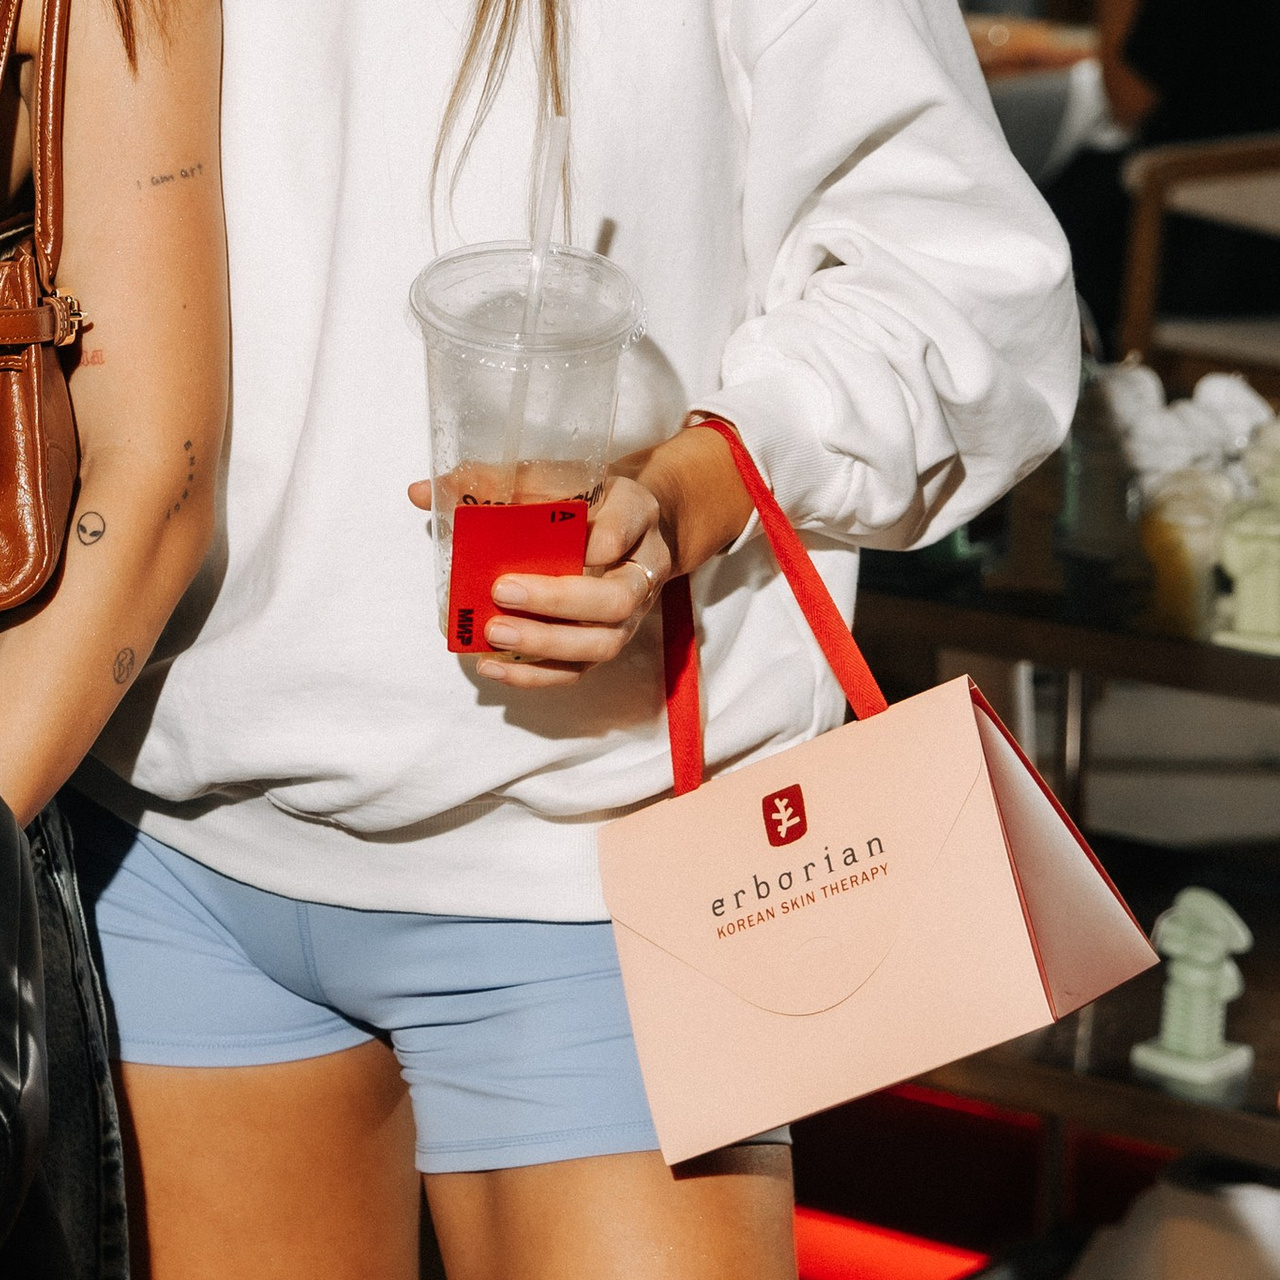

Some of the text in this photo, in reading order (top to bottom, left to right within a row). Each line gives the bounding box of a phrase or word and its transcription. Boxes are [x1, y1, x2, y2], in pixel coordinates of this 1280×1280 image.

[711, 836, 885, 917] erborian
[716, 862, 889, 940] KOREAN SKIN THERAPY
